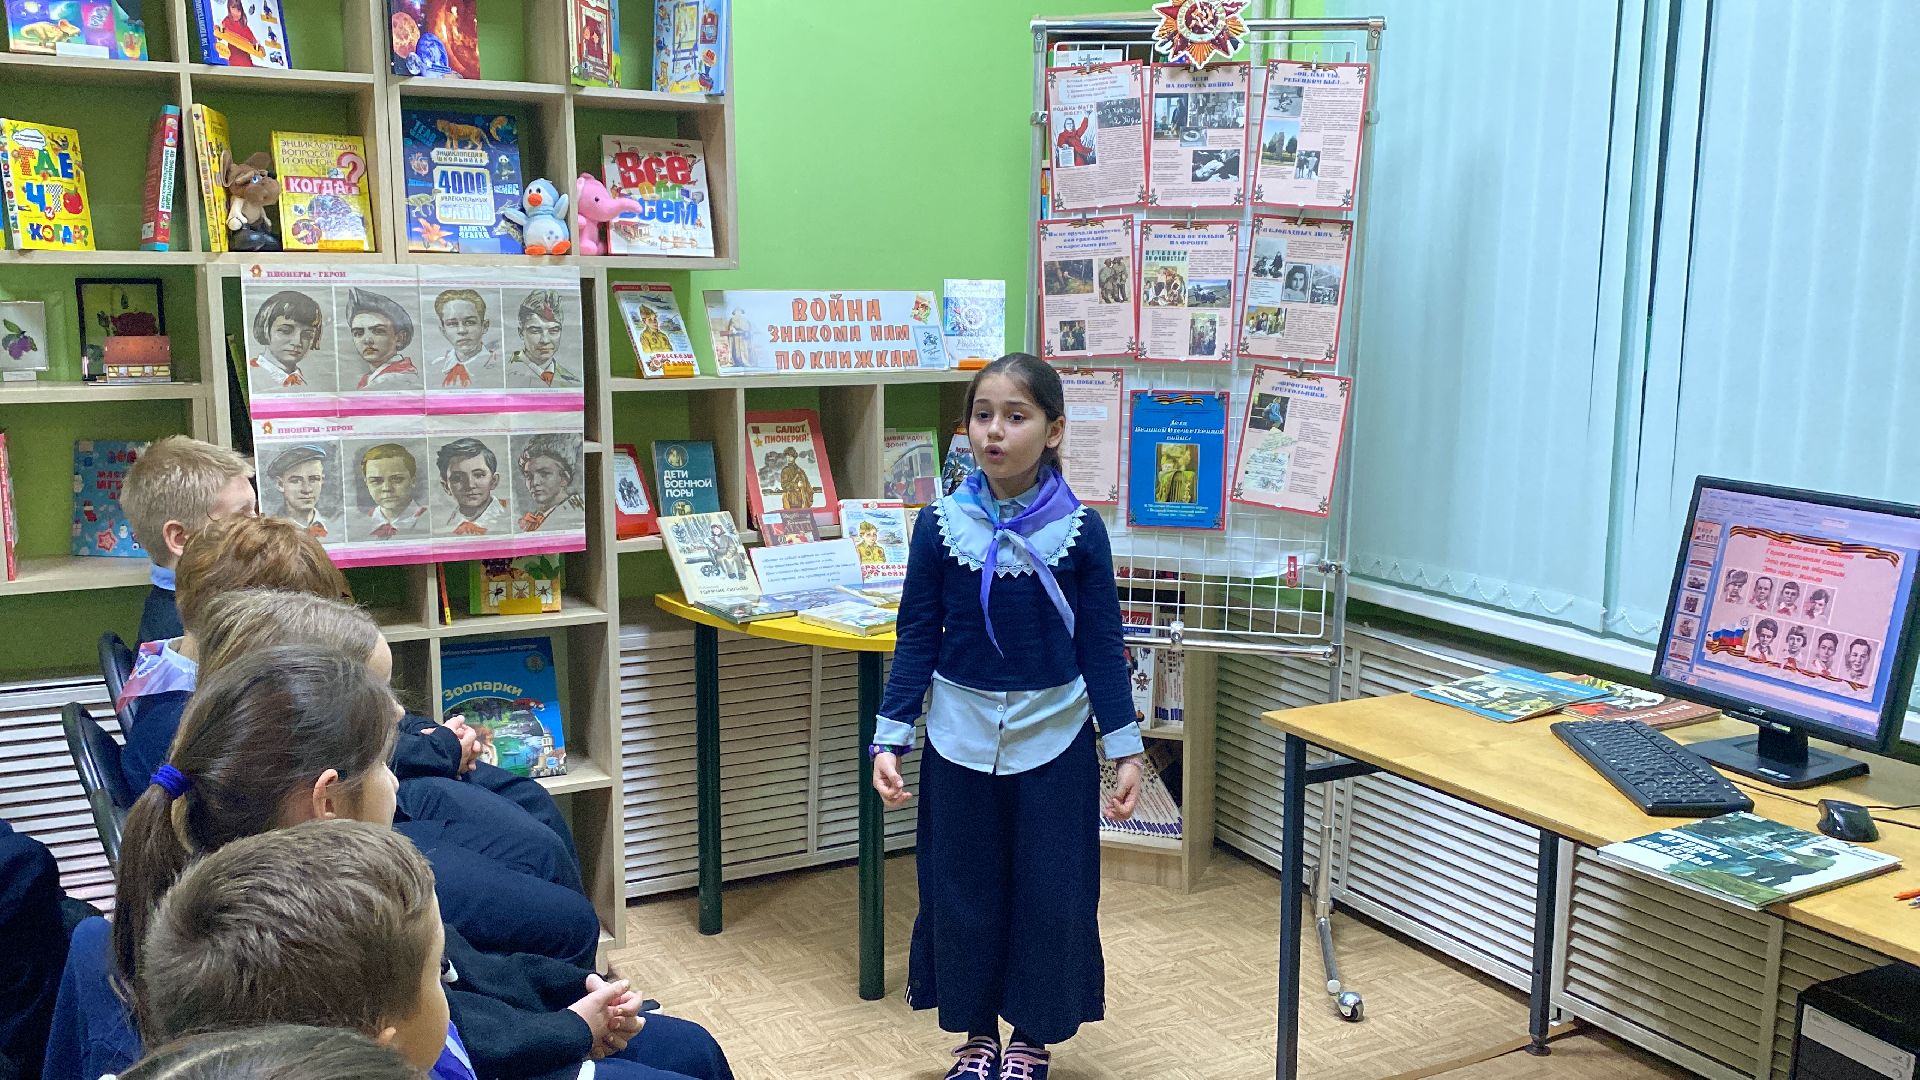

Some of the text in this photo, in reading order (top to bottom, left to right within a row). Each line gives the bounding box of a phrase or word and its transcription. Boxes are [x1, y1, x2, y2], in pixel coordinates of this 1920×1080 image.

[281, 139, 358, 151] ЭНЦИКЛОПЕДИЯ
[282, 149, 333, 159] ВОПРОСОВ
[436, 150, 483, 158] ЭНЦИКЛОПЕДИЯ
[19, 146, 74, 180] ГДЕ
[438, 170, 488, 194] 4000
[791, 293, 882, 322] ВОЙНА
[767, 324, 910, 343] ЗНАКОМА НАМ
[775, 349, 919, 370] ПО КНИЖКАМ
[278, 426, 321, 434] ПИОНЕРЫ
[764, 432, 810, 444] ПИОНЕРИЯ!
[664, 470, 689, 480] ДЕТИ
[664, 478, 713, 488] ВОЕННОЙ
[665, 488, 694, 498] ПОРЫ
[442, 681, 523, 701] Зоопарки
[1748, 706, 1766, 715] acer
